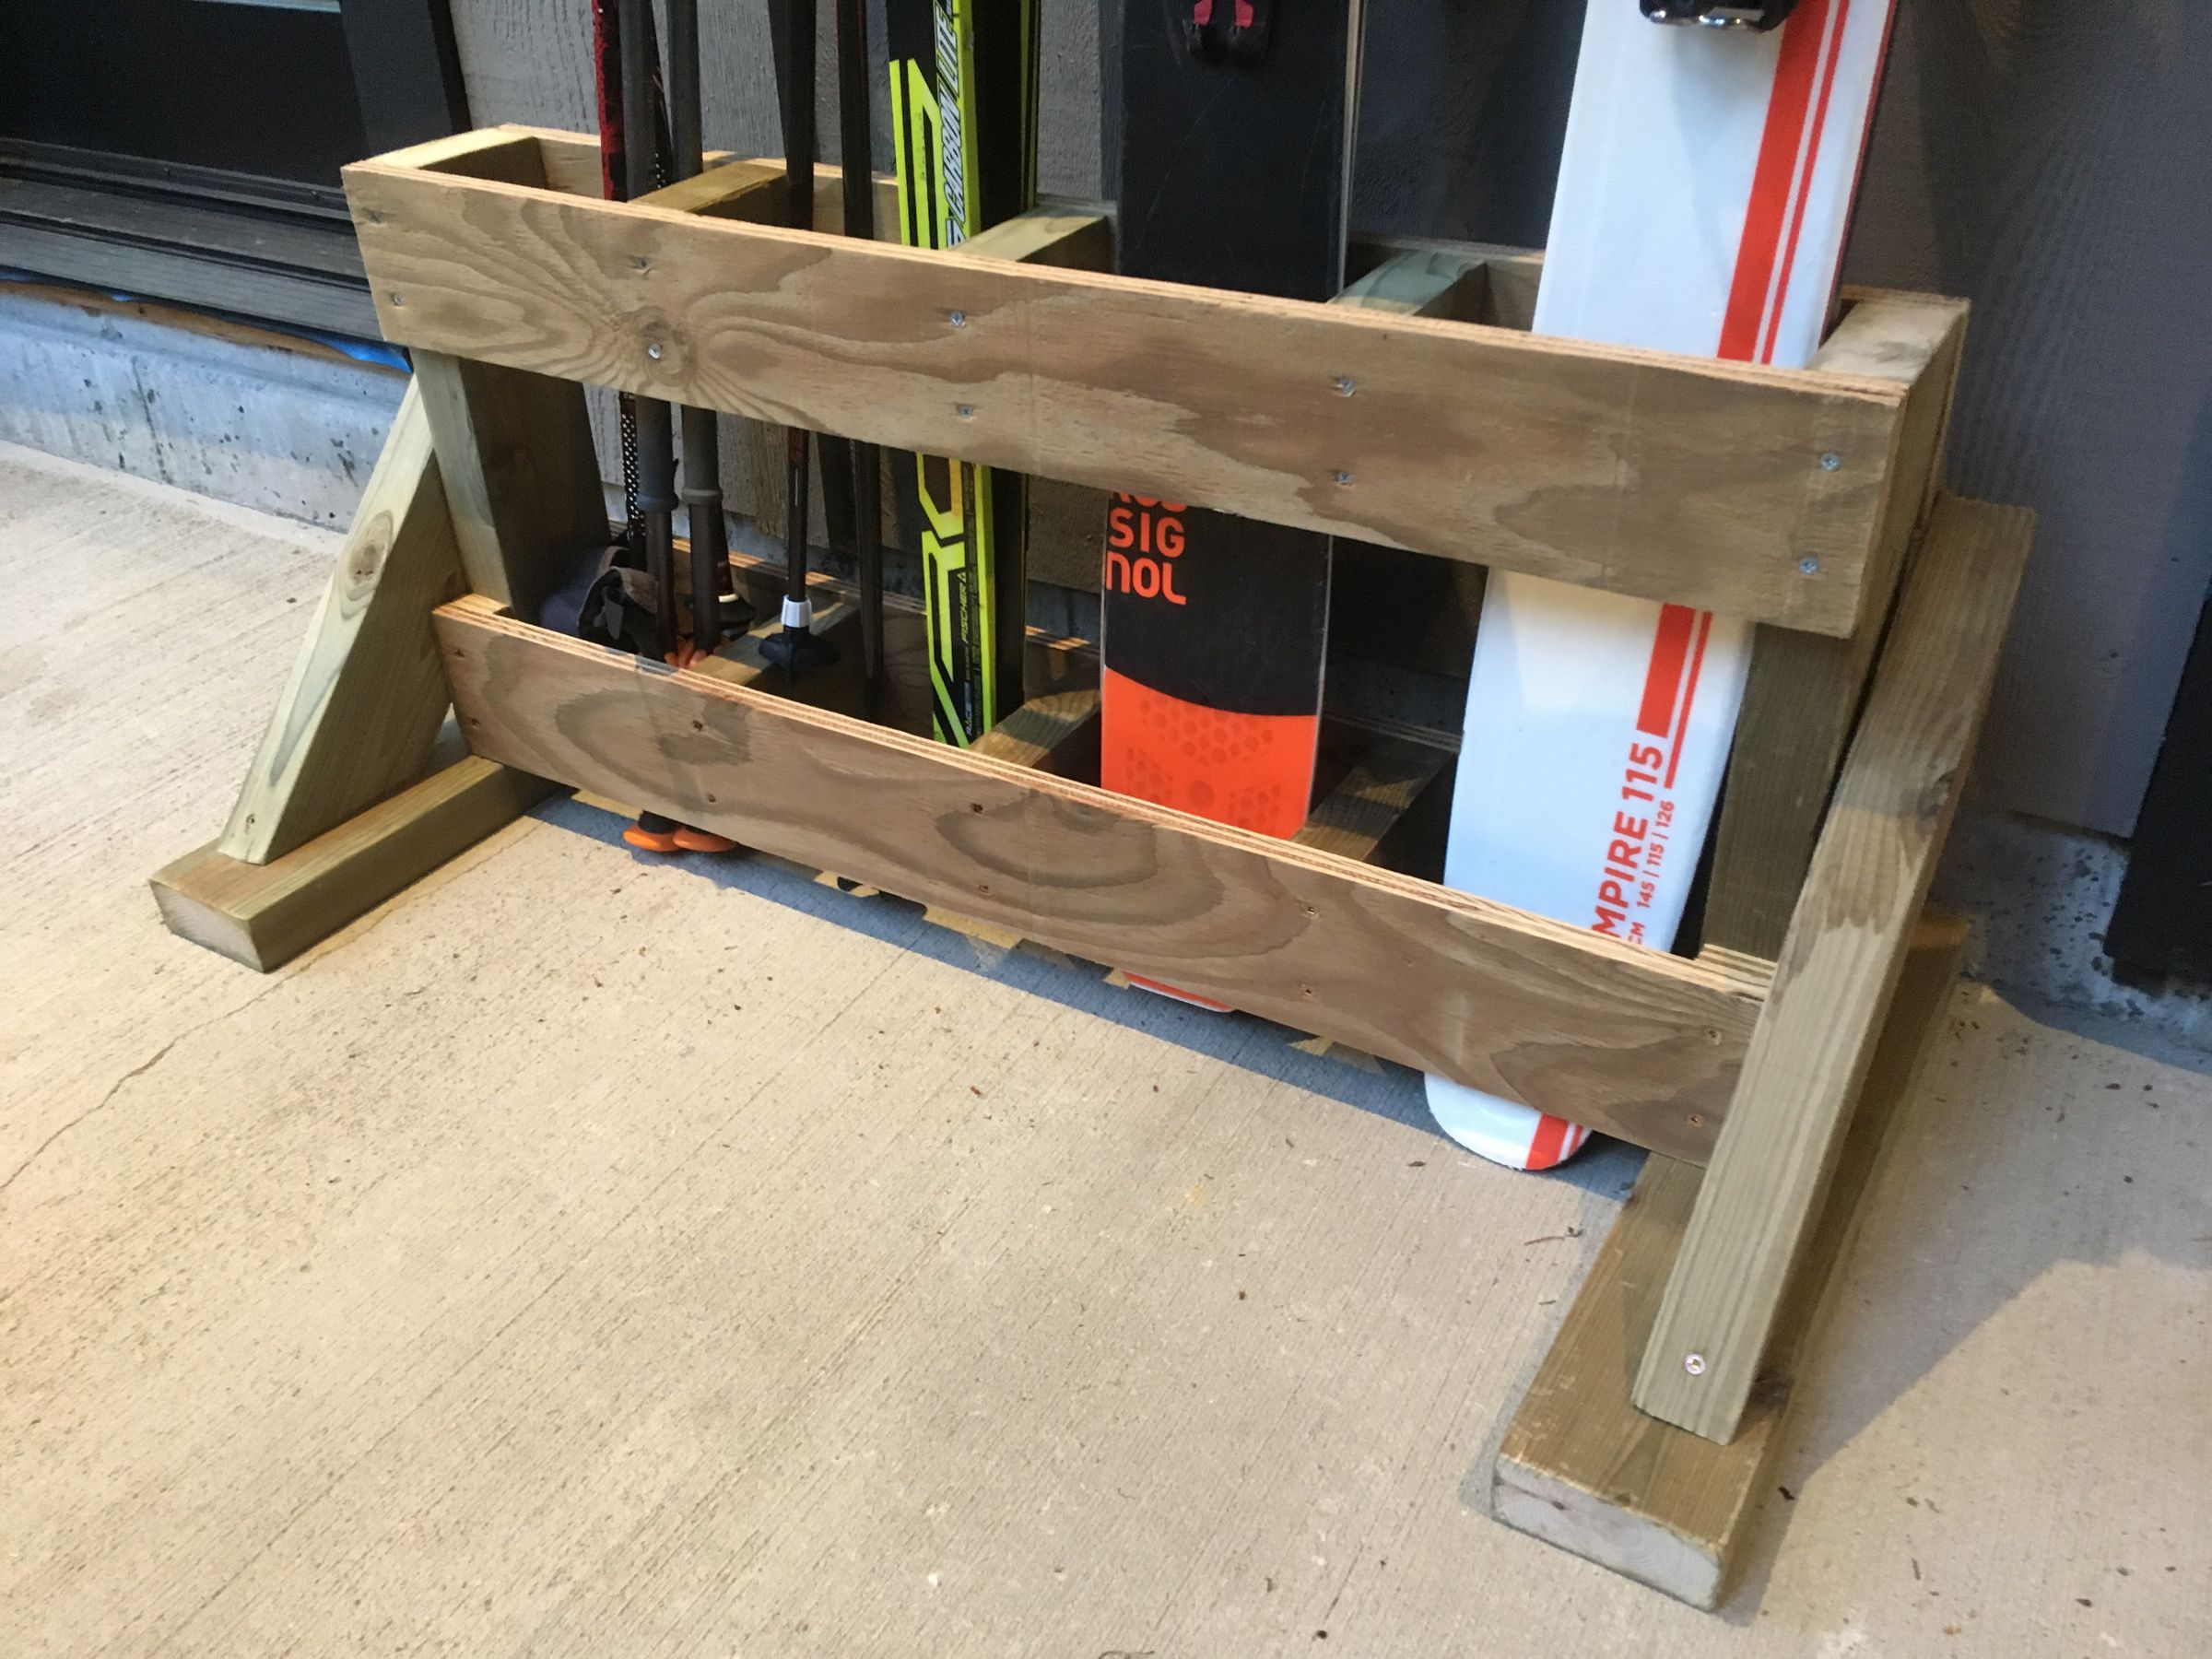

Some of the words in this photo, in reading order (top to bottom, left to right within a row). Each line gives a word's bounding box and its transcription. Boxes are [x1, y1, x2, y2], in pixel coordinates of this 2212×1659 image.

[935, 3, 959, 95] LITE
[939, 76, 965, 223] CARBON
[1109, 507, 1185, 559] SIG
[959, 582, 969, 644] FISCHER
[1621, 742, 1664, 802] 115
[1655, 800, 1675, 828] 126
[1647, 841, 1665, 866] 115
[1637, 880, 1655, 909] 145
